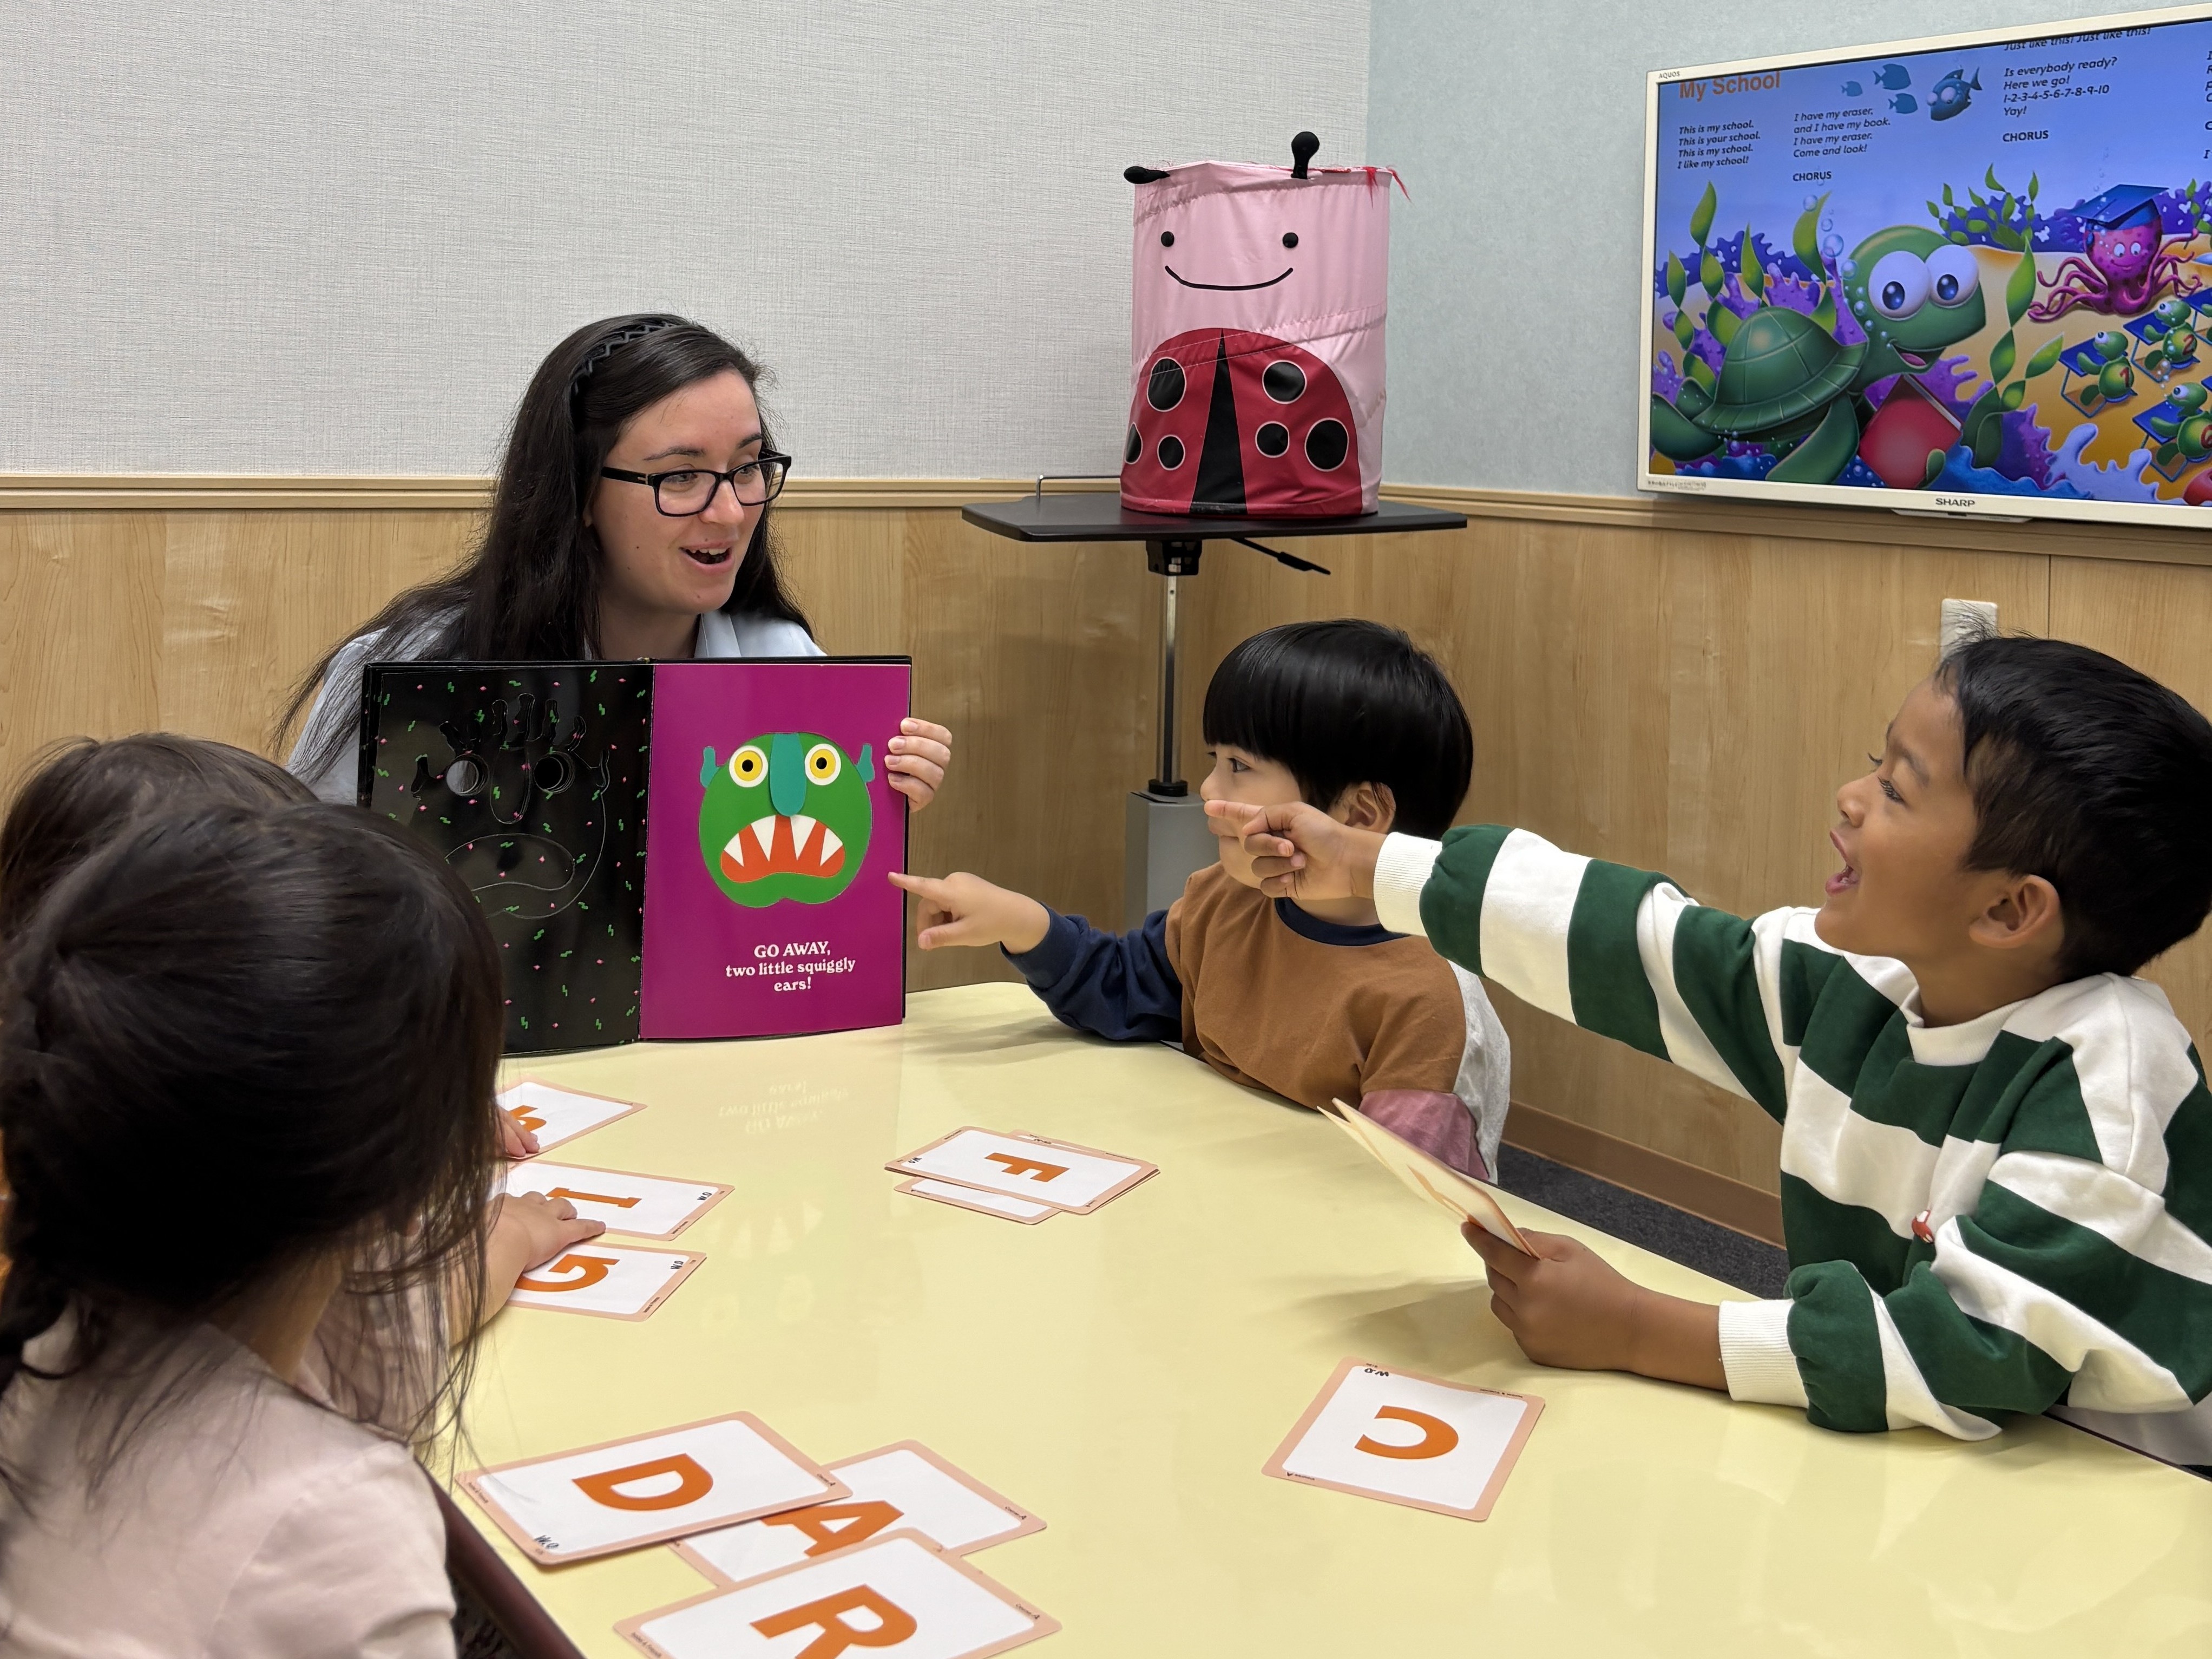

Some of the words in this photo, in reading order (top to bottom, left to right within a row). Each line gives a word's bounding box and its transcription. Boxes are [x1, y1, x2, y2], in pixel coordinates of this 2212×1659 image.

[2004, 68, 2014, 77] Is
[2017, 61, 2075, 76] everybody
[2078, 56, 2118, 69] ready?
[1658, 71, 1681, 79] AQUOS
[2004, 80, 2029, 90] Here
[2032, 79, 2048, 88] we
[2051, 75, 2070, 88] go!
[1680, 81, 1706, 102] My
[1712, 71, 1781, 95] School
[1794, 113, 1799, 121] I
[1801, 113, 1823, 121] have
[1826, 111, 1840, 120] my
[1842, 108, 1873, 117] eraser.
[2004, 106, 2027, 117] Yay!
[1679, 126, 1696, 135] This
[1698, 124, 1704, 133] is
[1706, 124, 1721, 133] my
[1722, 120, 1754, 130] school.
[1794, 124, 1812, 134] and
[1814, 123, 1819, 132] I
[1821, 122, 1845, 132] have
[1847, 121, 1861, 130] my
[1863, 117, 1891, 127] book.
[1678, 137, 1695, 146] This
[1698, 136, 1704, 145] is
[1706, 135, 1727, 146] your
[1729, 131, 1761, 142] school.
[1793, 137, 1798, 146] I
[1800, 137, 1823, 145] have
[1825, 135, 1840, 145] my
[1841, 132, 1873, 142] eraser.
[2003, 130, 2049, 142] CHORUS
[1678, 149, 1695, 158] This
[1697, 148, 1704, 156] is
[1706, 147, 1720, 156] my
[1722, 143, 1754, 154] school.
[1793, 149, 1820, 158] Come
[1822, 146, 1841, 155] and
[1843, 144, 1867, 154] look!
[1677, 161, 1682, 169] I
[1684, 160, 1698, 168] like
[1701, 160, 1715, 169] my
[1716, 156, 1749, 166] school!
[1793, 171, 1832, 182] CHORUS
[1935, 497, 1975, 507] SHARP
[754, 944, 779, 958] GO
[783, 941, 831, 956] AWAY,
[725, 965, 756, 977] two
[759, 961, 794, 975] little
[797, 957, 856, 974] squiggly
[774, 976, 811, 992] ears!
[984, 1152, 1071, 1182] F
[514, 1254, 620, 1293] G
[1354, 1405, 1460, 1460] C
[572, 1453, 713, 1512] D
[760, 1500, 904, 1558] A
[749, 1583, 918, 1659] R
